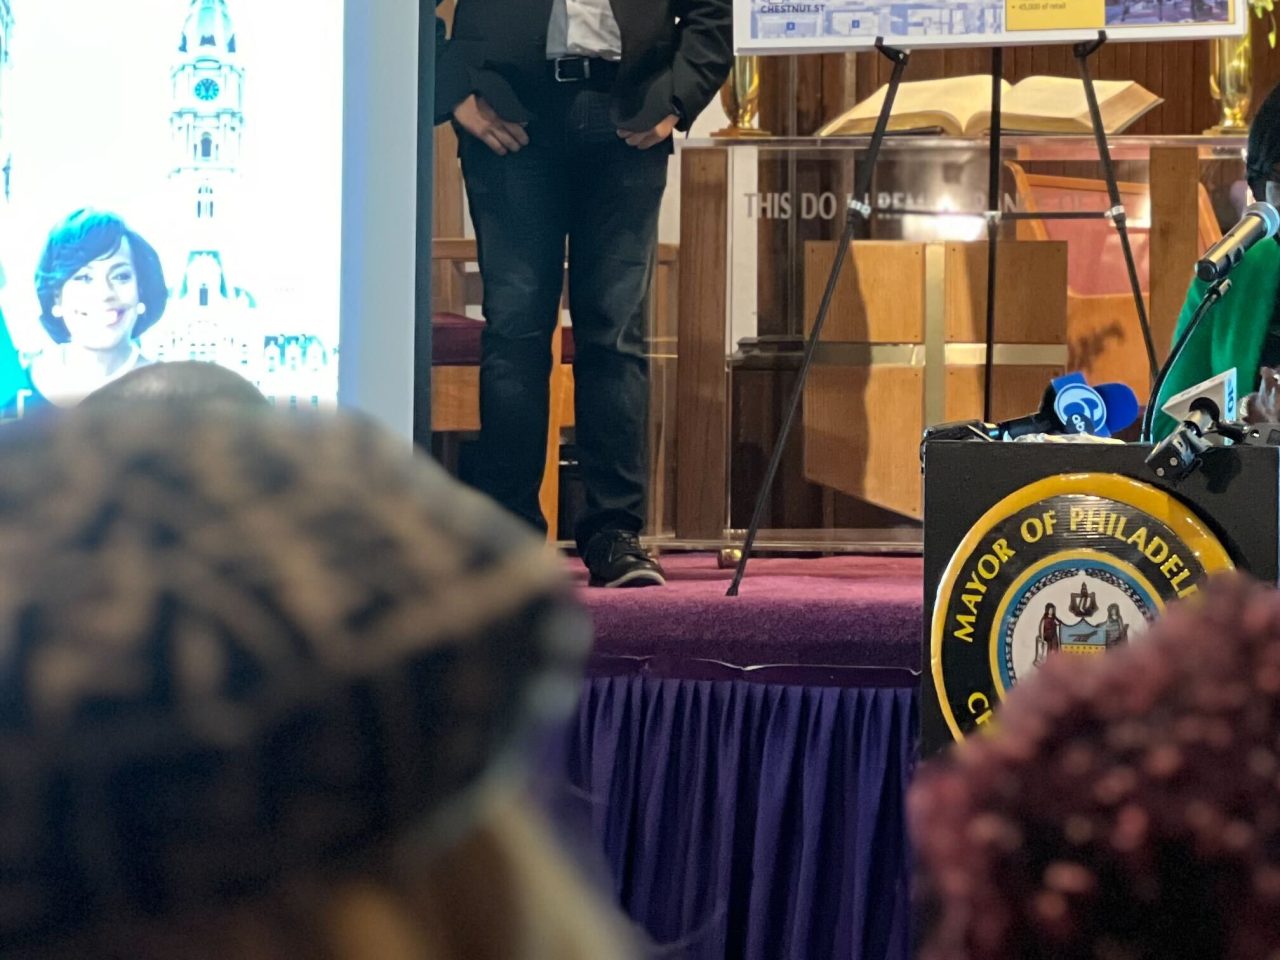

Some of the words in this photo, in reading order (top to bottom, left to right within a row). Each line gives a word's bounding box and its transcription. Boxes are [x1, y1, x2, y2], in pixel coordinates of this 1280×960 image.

[760, 3, 812, 15] CHESTNUT
[813, 3, 825, 13] ST
[743, 192, 791, 220] THIS
[800, 192, 838, 220] DO
[953, 538, 1016, 643] MAYOR
[1020, 509, 1057, 544] OF
